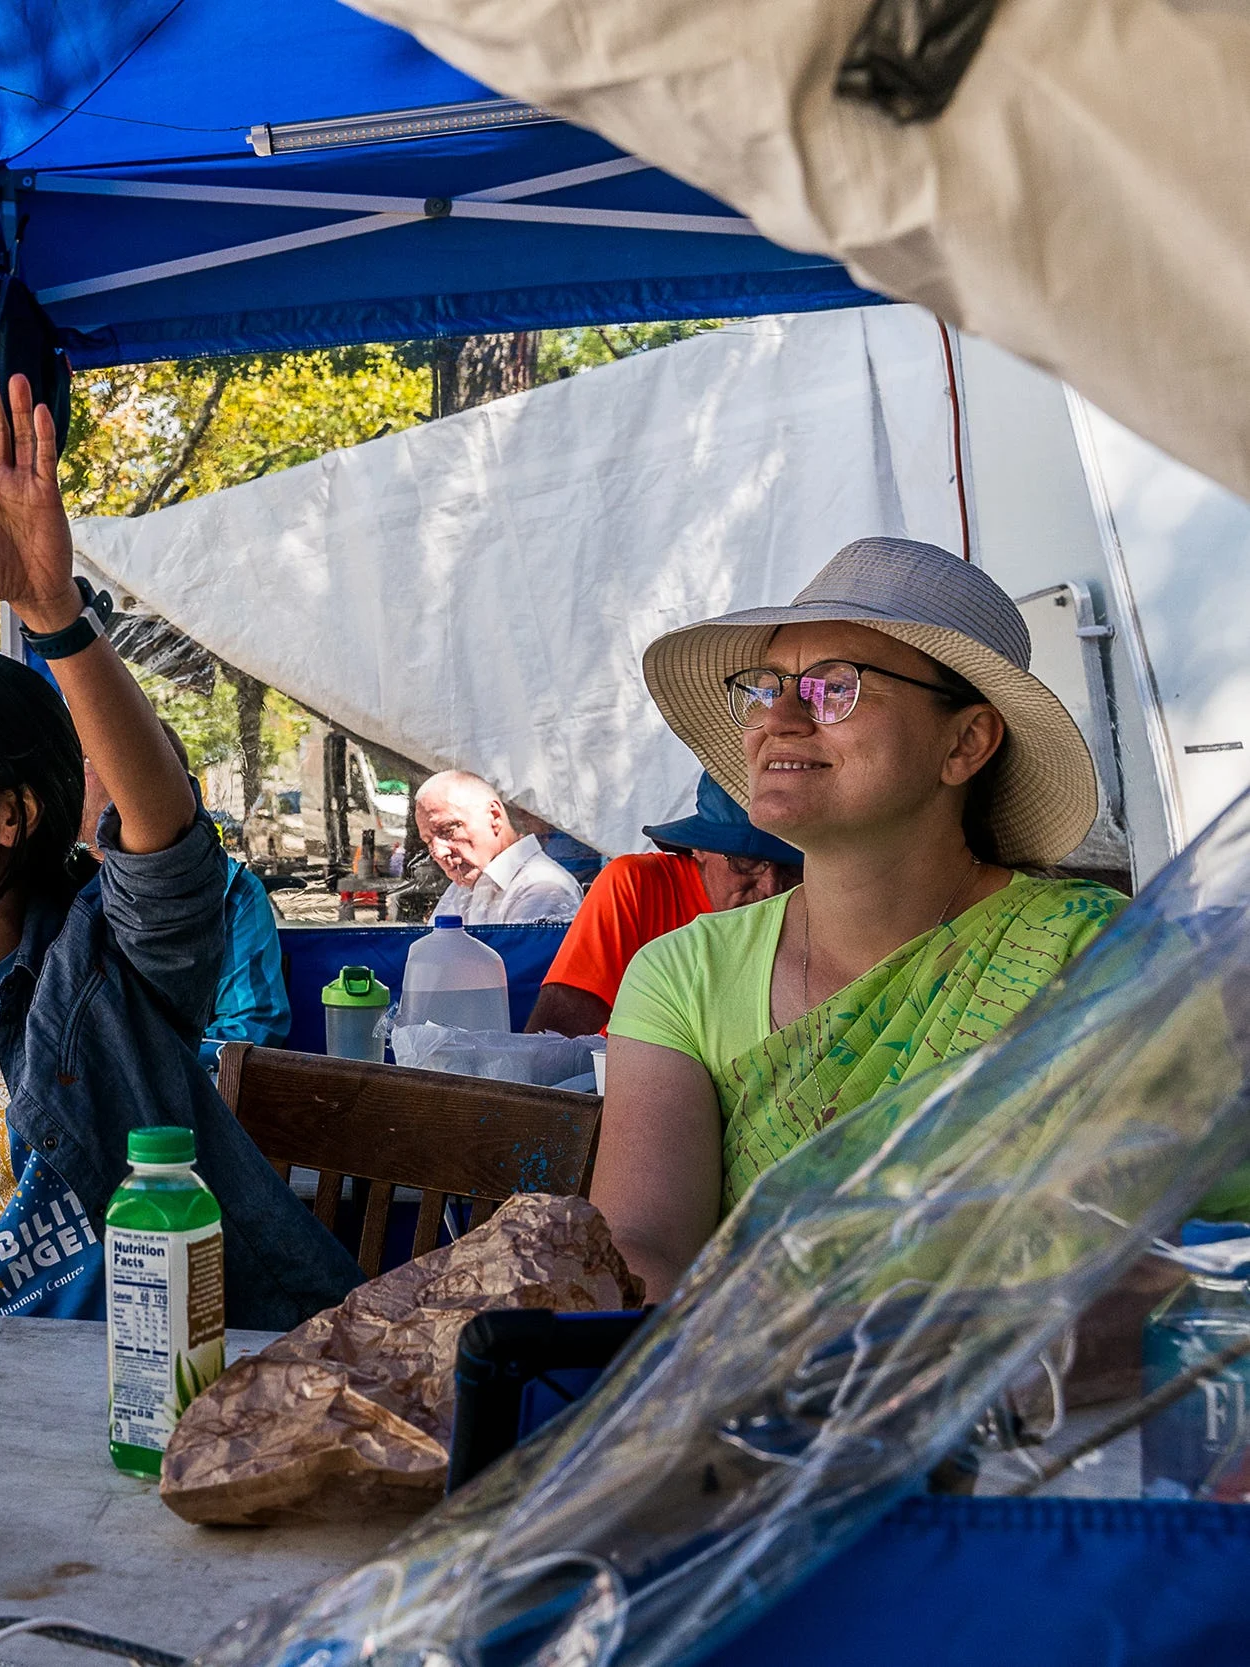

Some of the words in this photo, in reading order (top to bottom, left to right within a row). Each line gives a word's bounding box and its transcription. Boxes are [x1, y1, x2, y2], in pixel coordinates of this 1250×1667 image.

[114, 1240, 165, 1257] Nutrition
[114, 1253, 144, 1268] Facts
[46, 1264, 85, 1292] Centres
[154, 1293, 168, 1305] 120
